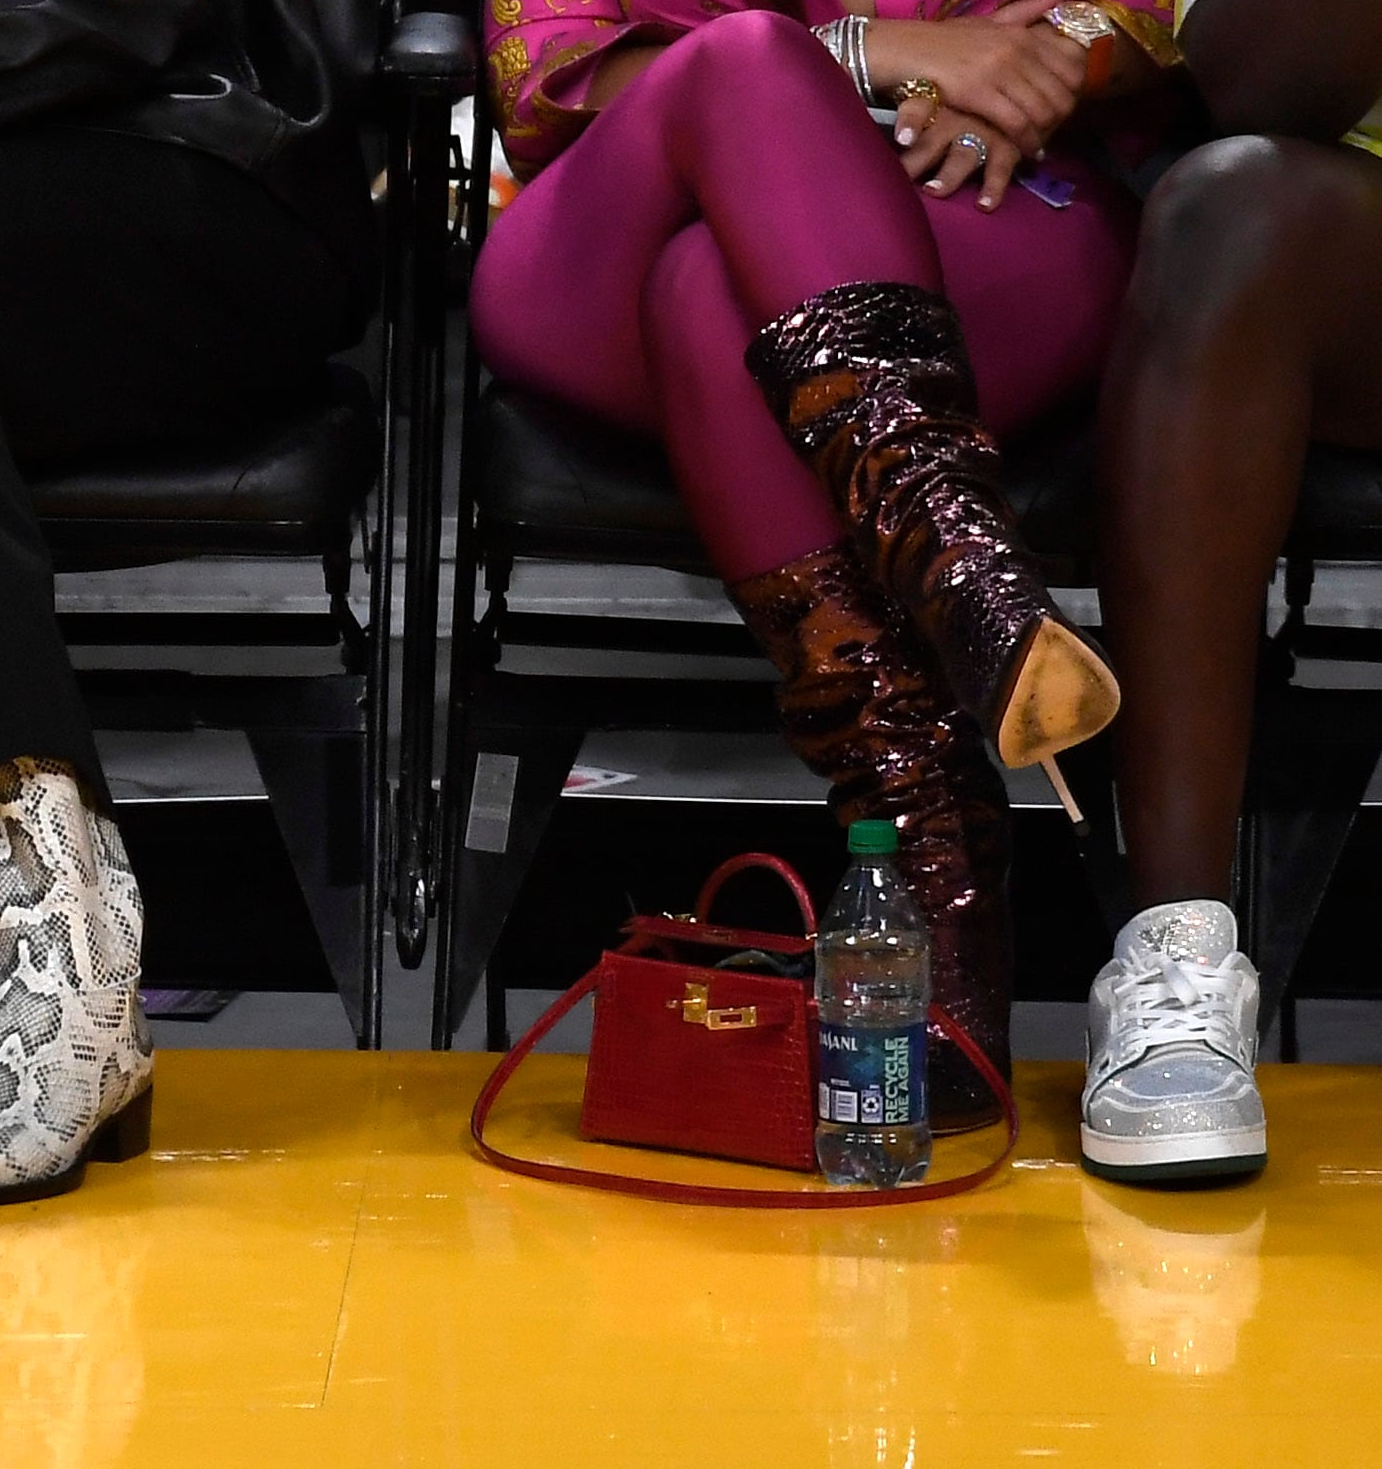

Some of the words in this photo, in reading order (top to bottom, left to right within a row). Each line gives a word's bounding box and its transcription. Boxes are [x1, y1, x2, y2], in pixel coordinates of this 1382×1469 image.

[884, 1038, 898, 1124] RECYCLE
[898, 1036, 909, 1091] AGAIN
[898, 1094, 909, 1122] ME
